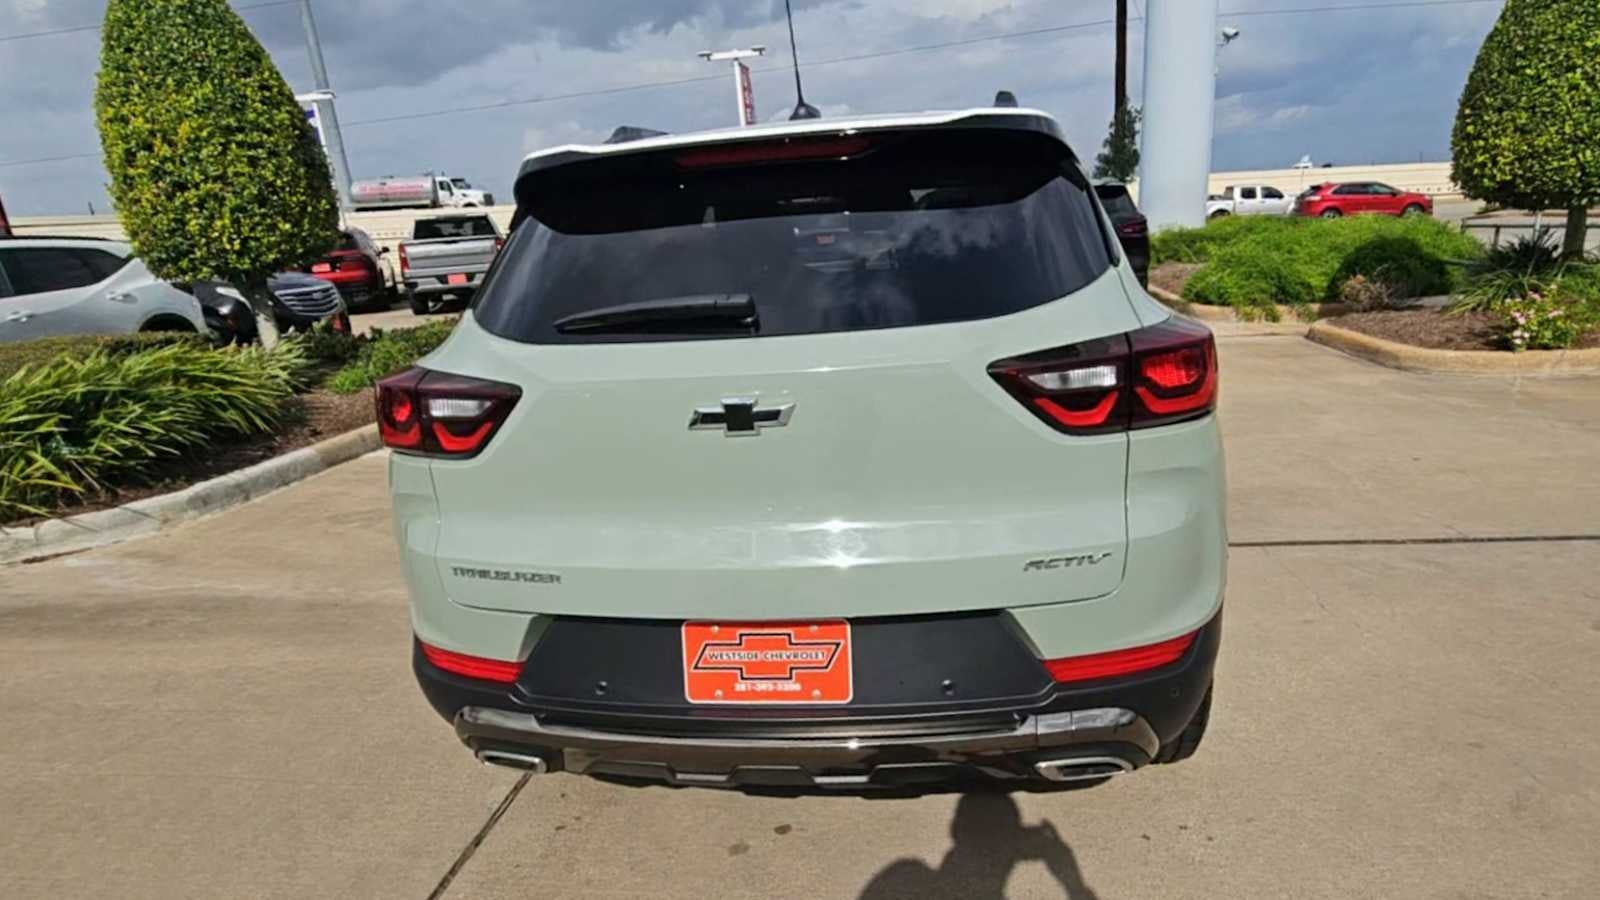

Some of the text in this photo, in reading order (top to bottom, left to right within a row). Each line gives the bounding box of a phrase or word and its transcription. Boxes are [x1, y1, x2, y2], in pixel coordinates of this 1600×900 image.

[1023, 552, 1111, 571] ACTIV
[451, 567, 562, 584] TRAILBLAZER
[707, 650, 826, 662] WESTSIDE CHEVROLET
